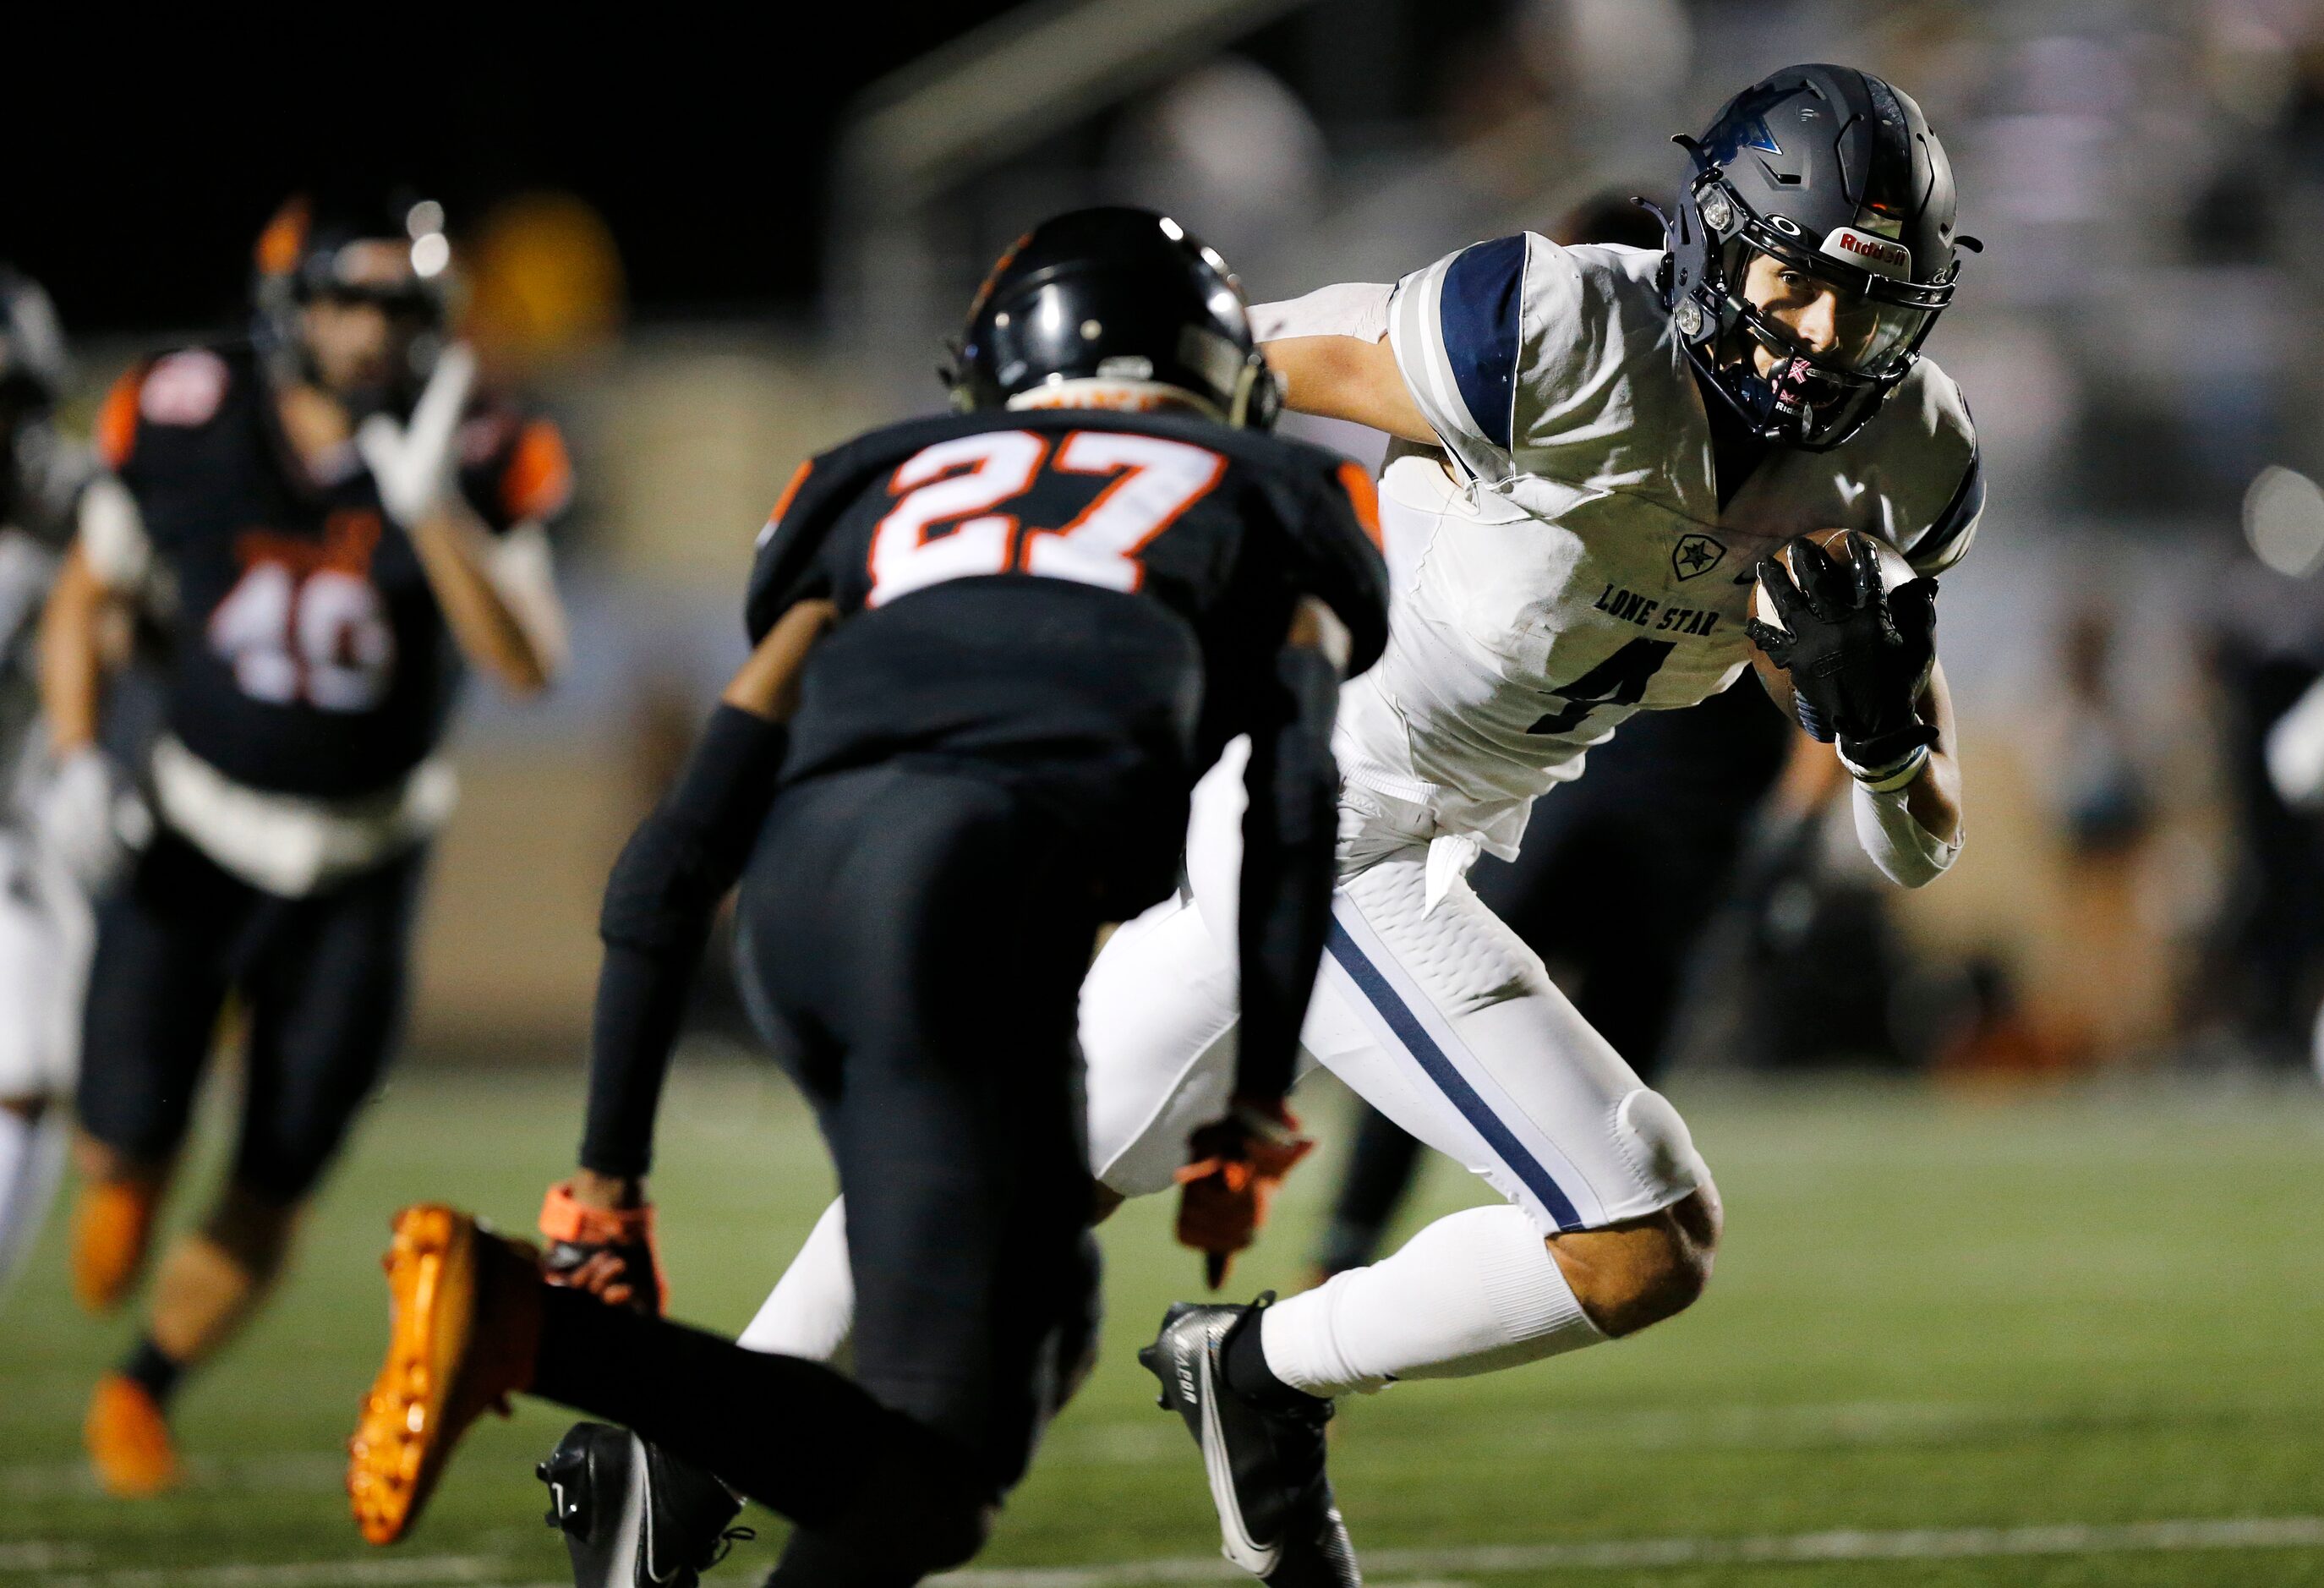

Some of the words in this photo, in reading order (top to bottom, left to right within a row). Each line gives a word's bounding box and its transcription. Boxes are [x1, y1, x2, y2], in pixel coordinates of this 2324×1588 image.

[1839, 233, 1907, 266] Riddell
[864, 429, 1230, 610] 27
[1594, 583, 1659, 627] LONE
[1656, 608, 1720, 636] STAR
